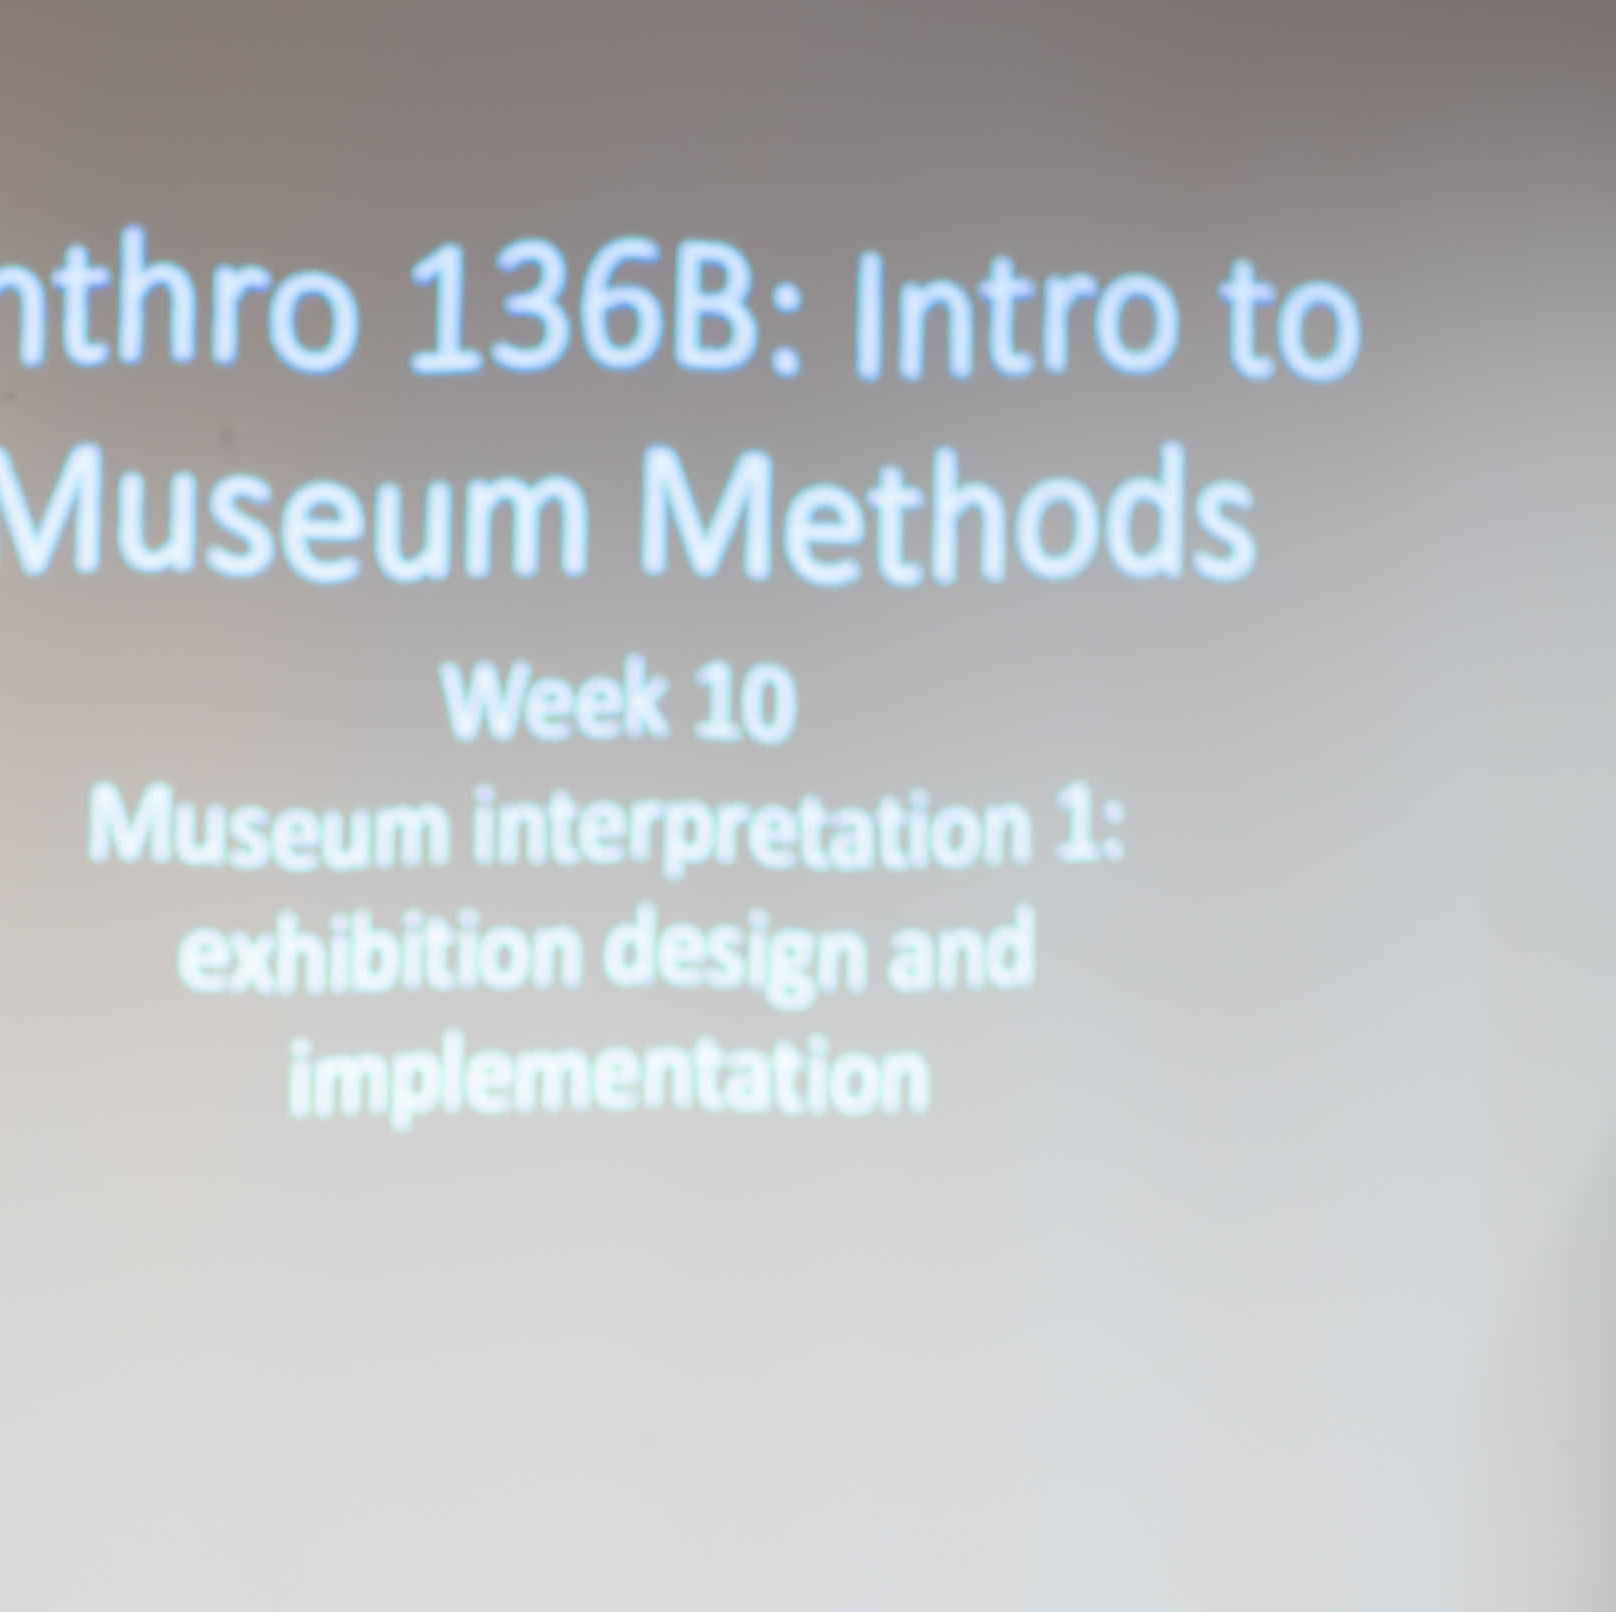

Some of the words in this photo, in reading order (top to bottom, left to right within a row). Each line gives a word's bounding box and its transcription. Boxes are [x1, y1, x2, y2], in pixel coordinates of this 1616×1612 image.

[408, 234, 803, 380] 136B:
[854, 248, 1181, 384] Intro
[1217, 257, 1363, 385] to
[640, 438, 1257, 588] Methods
[439, 651, 671, 742] Week
[694, 657, 798, 745] 10
[88, 781, 450, 872] Museum
[473, 782, 1032, 882] interpretation
[1056, 781, 1125, 863] 1:
[178, 908, 583, 995] exhibition
[603, 901, 867, 1011] design
[888, 904, 1035, 992] and
[289, 1029, 929, 1131] implementation
